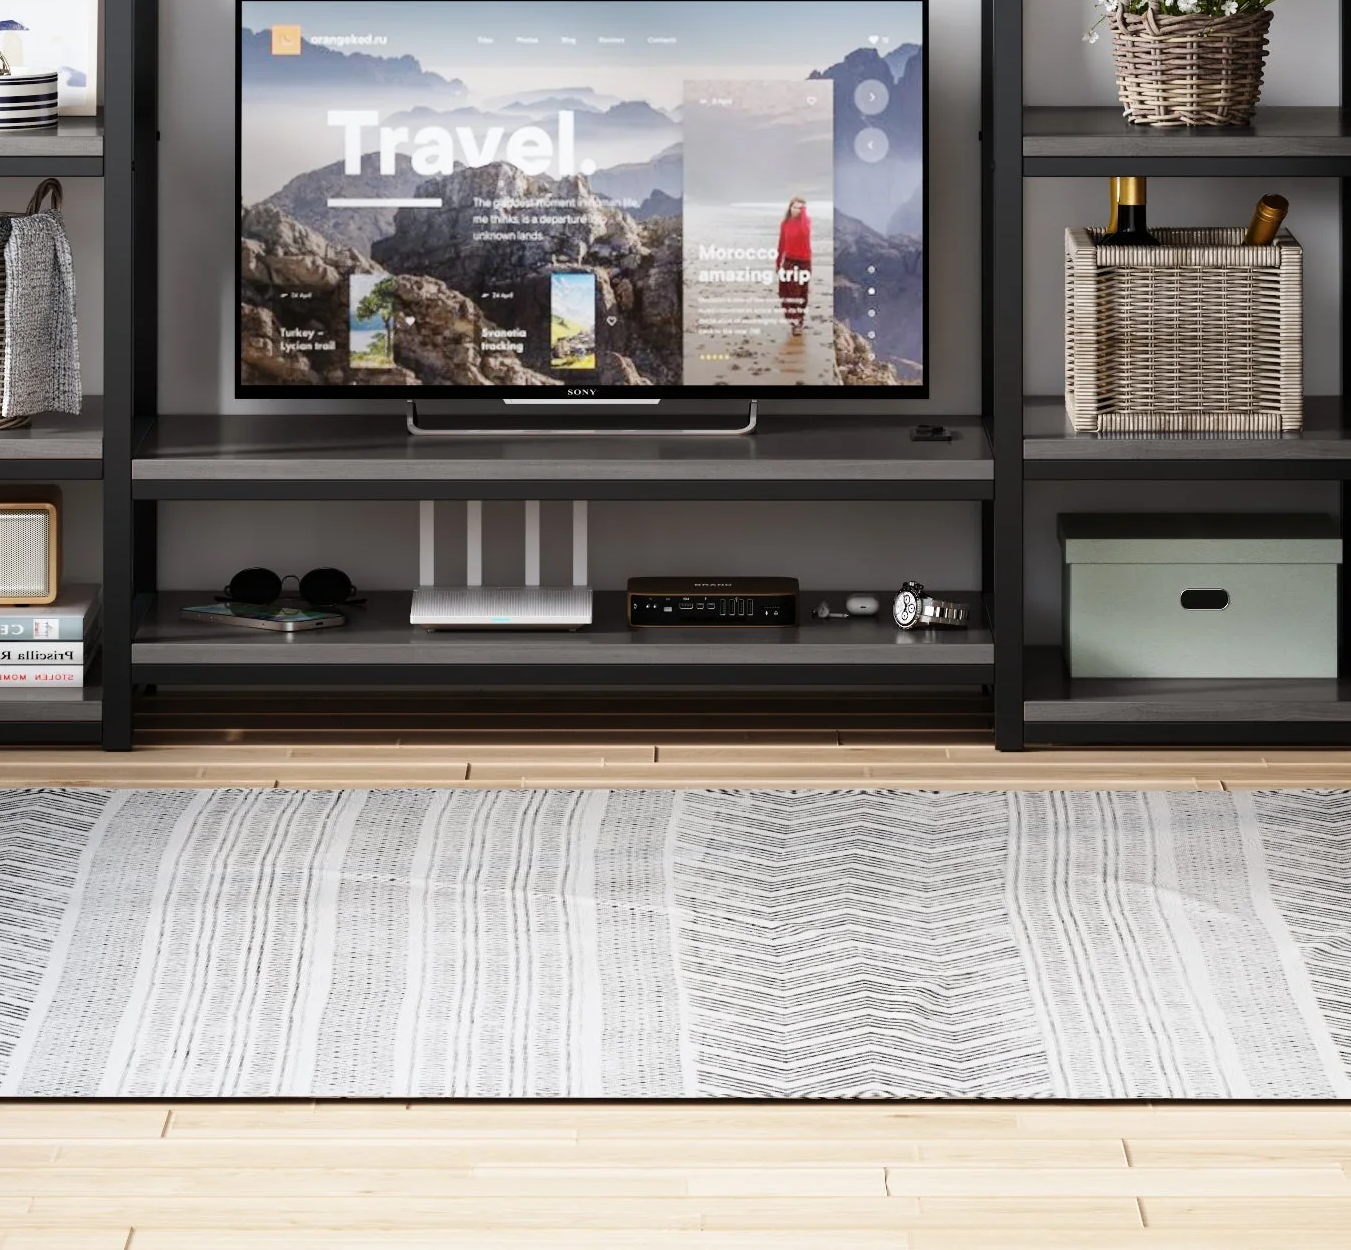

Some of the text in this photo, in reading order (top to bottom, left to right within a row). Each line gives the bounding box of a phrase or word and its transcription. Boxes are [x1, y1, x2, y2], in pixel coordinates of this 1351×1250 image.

[327, 110, 598, 177] Travel.
[473, 197, 492, 207] The
[473, 216, 489, 224] me
[522, 215, 531, 224] is
[539, 214, 587, 226] departure
[473, 231, 516, 241] unknown
[699, 244, 779, 260] Morocco
[698, 265, 810, 285] amazing trip
[280, 327, 315, 341] Turkey
[314, 340, 336, 350] trail
[567, 388, 597, 396] SONY
